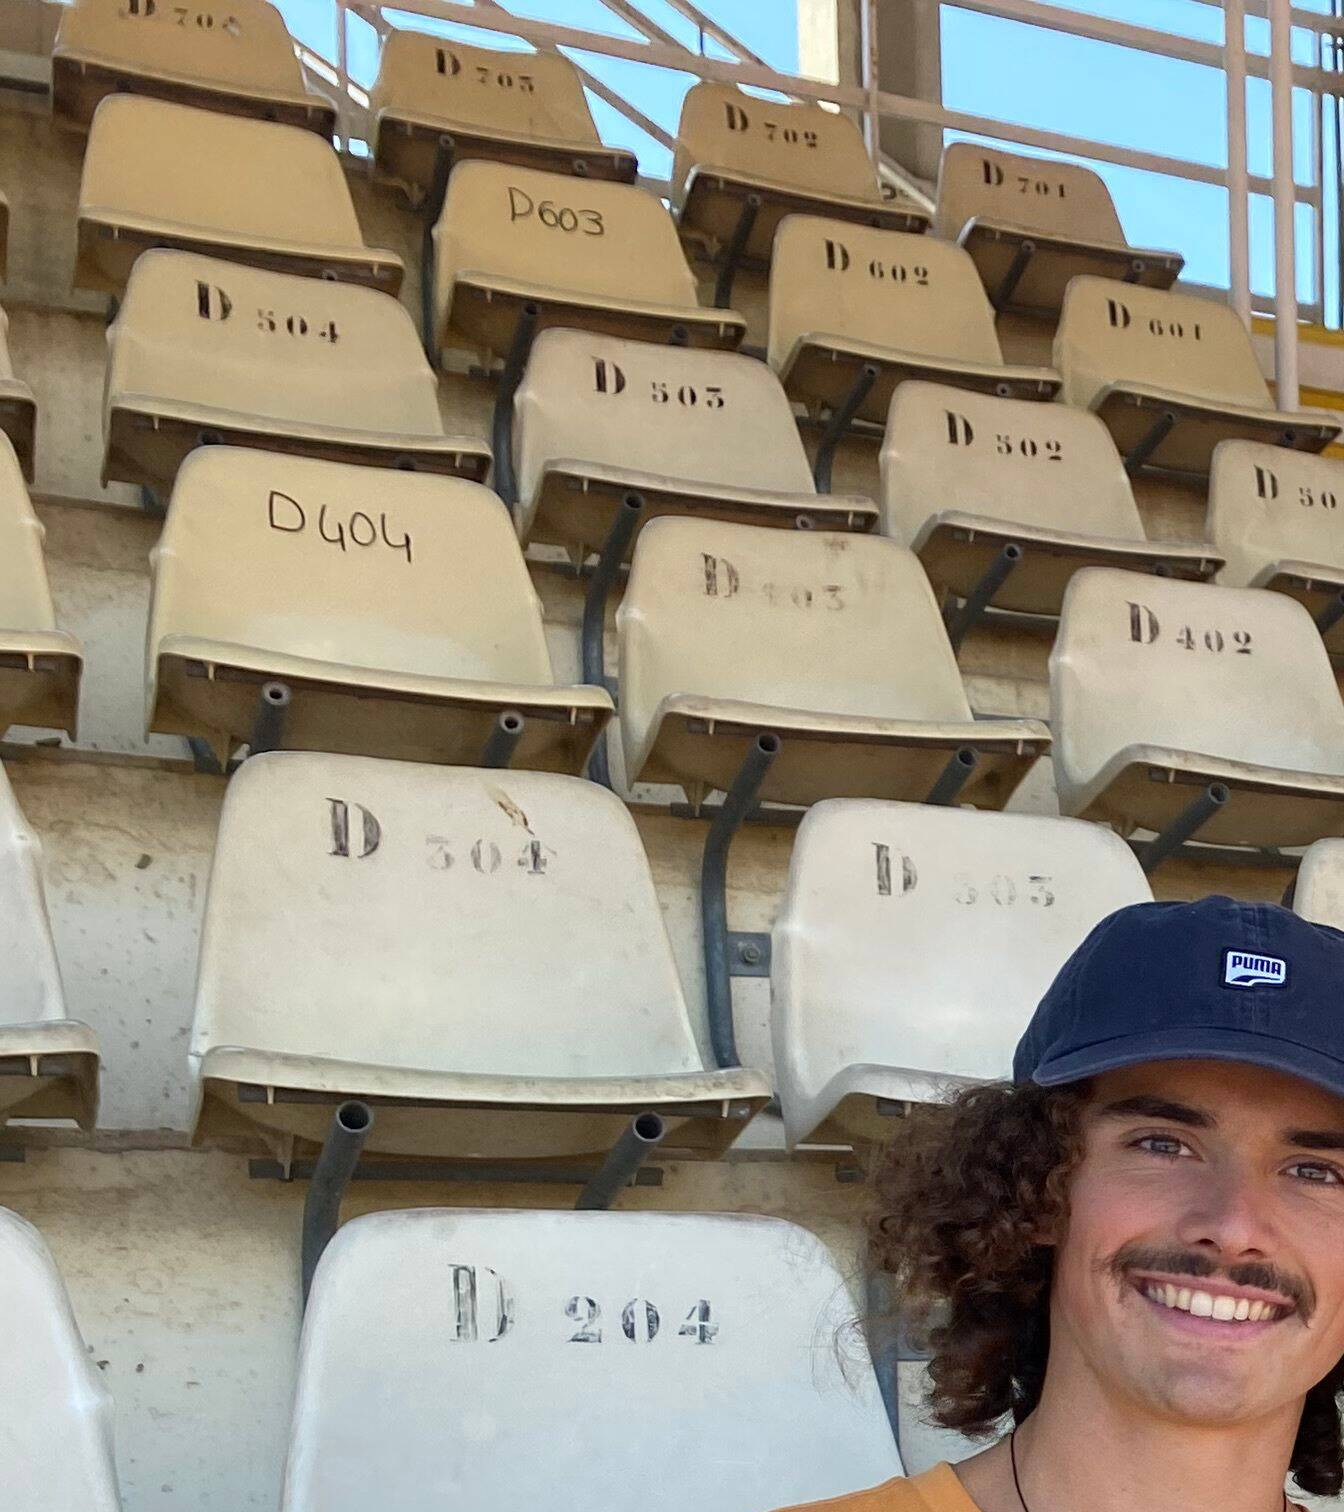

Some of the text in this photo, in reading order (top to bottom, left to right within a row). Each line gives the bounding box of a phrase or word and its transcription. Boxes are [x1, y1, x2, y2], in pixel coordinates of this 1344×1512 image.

[436, 49, 461, 75] D
[726, 103, 817, 148] D 702
[983, 160, 1065, 198] D 701
[508, 187, 604, 237] D603
[826, 240, 928, 285] D 602
[194, 279, 341, 344] D 504
[1108, 300, 1200, 340] D 601
[590, 355, 725, 410] D 503
[946, 410, 1062, 461] D 502
[1254, 465, 1278, 499] D
[269, 491, 411, 563] D404
[701, 552, 739, 597] D
[1127, 602, 1251, 654] D 402
[326, 798, 381, 859] D
[871, 842, 917, 896] D
[1231, 955, 1282, 976] PUMA
[448, 1264, 716, 1345] D 204
